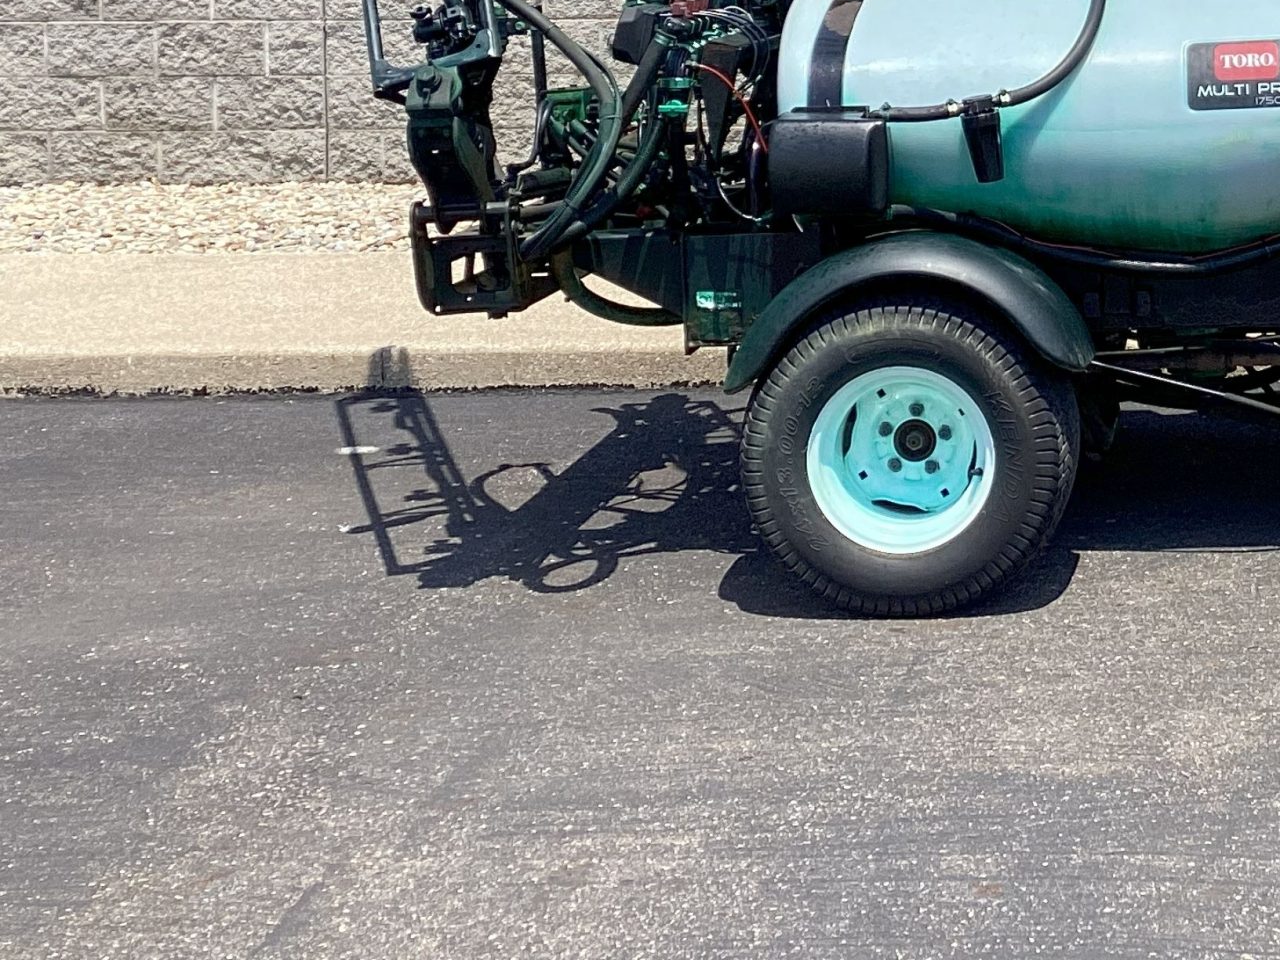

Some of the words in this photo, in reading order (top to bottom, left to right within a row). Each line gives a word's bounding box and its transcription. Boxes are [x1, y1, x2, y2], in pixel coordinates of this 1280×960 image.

[1219, 52, 1276, 69] TORO
[1197, 83, 1250, 97] MULTI
[983, 391, 1025, 522] KENDA
